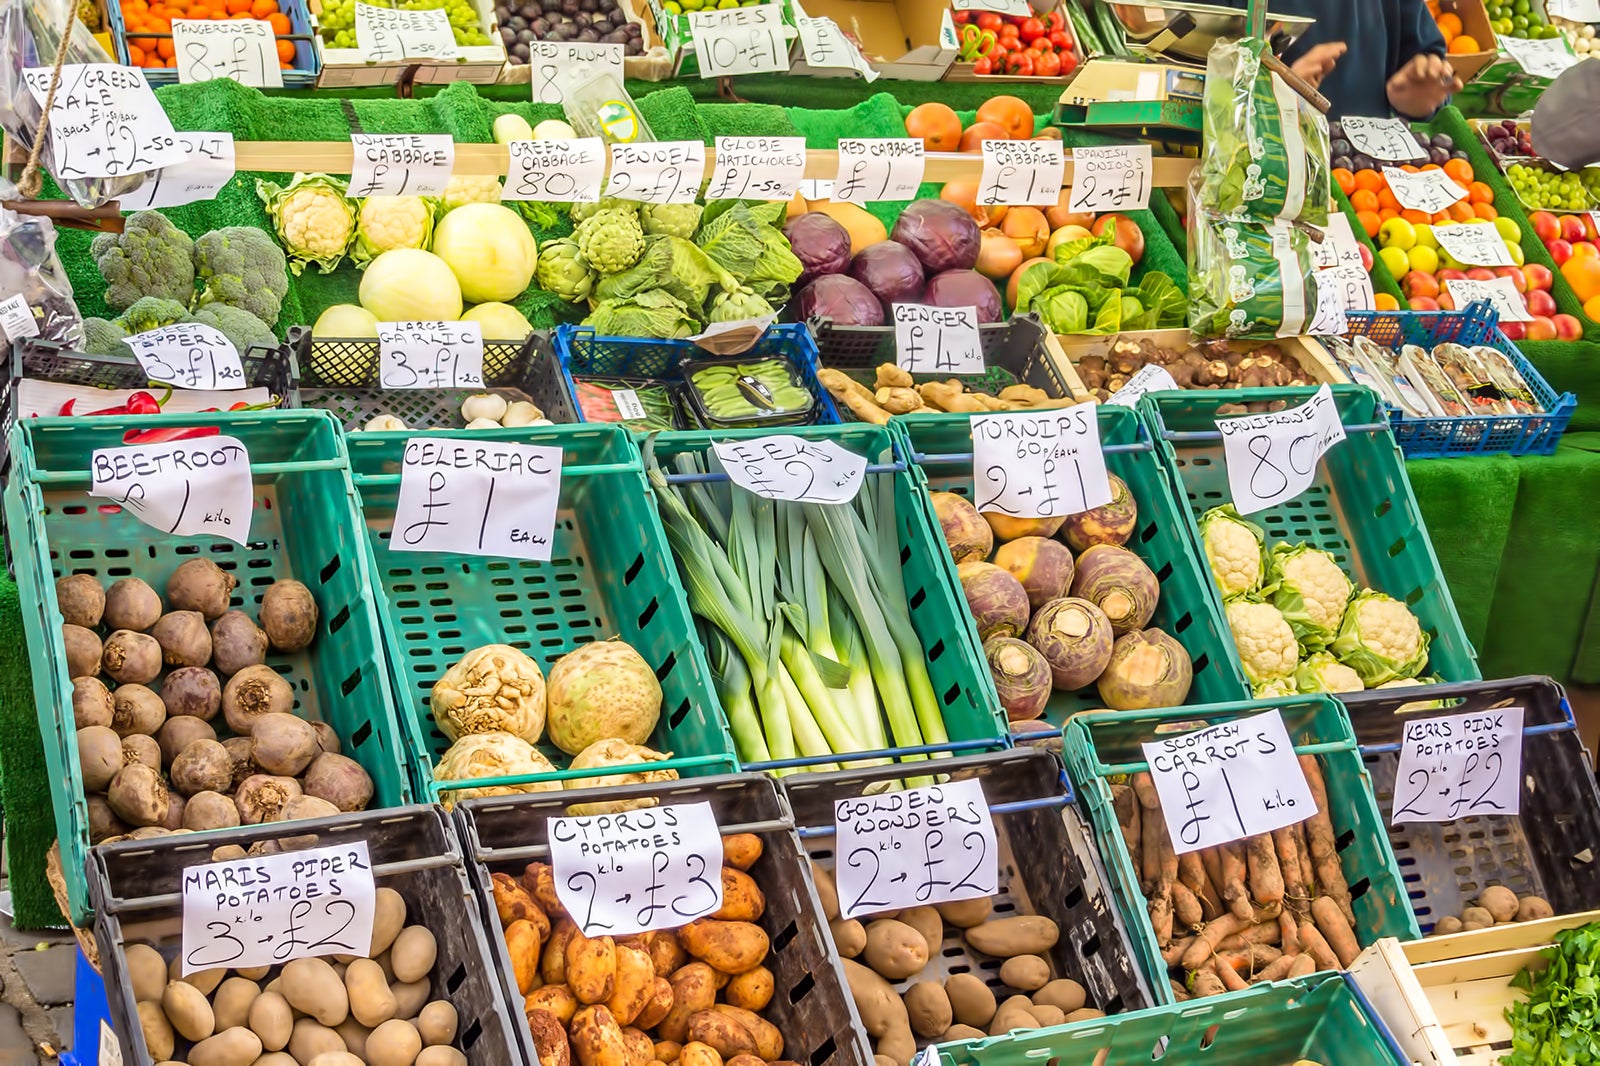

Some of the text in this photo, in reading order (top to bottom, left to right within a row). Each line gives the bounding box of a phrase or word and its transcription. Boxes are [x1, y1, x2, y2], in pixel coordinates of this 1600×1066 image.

[357, 4, 446, 23] SEEDLESS
[694, 9, 767, 28] LIMES
[173, 22, 266, 37] TANGERINES
[185, 36, 266, 87] 8 £1
[531, 43, 622, 65] RED PLUMS
[704, 29, 778, 71] 10 £1
[540, 65, 563, 104] 8
[51, 90, 114, 113] KALE
[63, 124, 90, 138] BAGS
[1342, 120, 1365, 130] RED
[355, 135, 425, 148] WHITE
[510, 141, 570, 157] GREEN
[613, 146, 700, 165] FENNEL
[722, 138, 781, 151] GLOBE
[840, 141, 922, 157] RED CABBAGE
[984, 141, 1040, 154] SPRING
[1076, 148, 1128, 160] SPANISH
[1384, 131, 1414, 158] £1
[366, 149, 448, 166] CABBAGE
[522, 152, 594, 170] CABBAGE
[717, 154, 803, 167] ARTICHOKES
[996, 152, 1058, 166] CABBAGE
[1087, 158, 1144, 171] ONIONS
[358, 164, 409, 196] £1
[603, 172, 631, 199] 2
[838, 161, 892, 200] £1
[984, 167, 1036, 205] £1
[1075, 170, 1144, 209] 2 £1
[395, 322, 450, 332] LARGE
[895, 306, 974, 329] GINGER
[137, 324, 202, 342] SWEET
[380, 333, 475, 345] GARLIC
[900, 326, 960, 372] £4
[384, 351, 418, 387] 3
[973, 411, 1087, 440] TURNIPS
[1220, 396, 1328, 436] CAULIFLOWER
[94, 446, 245, 482] BEETROOT
[404, 443, 551, 475] CELERIAC
[744, 461, 856, 502] £2 kilo
[978, 459, 1088, 515] 2 £1
[203, 508, 231, 524] kilo
[403, 472, 495, 549] £1
[1163, 724, 1239, 753] SCOTTISH
[1406, 715, 1503, 743] KERRS PINK
[1154, 733, 1276, 773] CARROTS
[1416, 734, 1500, 758] POTATOES
[1393, 769, 1432, 819] 2
[1448, 752, 1506, 818] £2
[836, 787, 944, 822] GOLDEN
[854, 801, 981, 835] WONDERS
[1180, 767, 1296, 844] £1 kilo
[553, 807, 678, 842] CYPRUS
[581, 832, 681, 857] POTATOES
[184, 851, 369, 895] MARIS PIPER
[847, 830, 995, 916] 2 kilo £2
[216, 879, 343, 911] POTATOES
[567, 851, 718, 933] 2 kilo £3
[187, 900, 356, 966] 3 kilo £2
